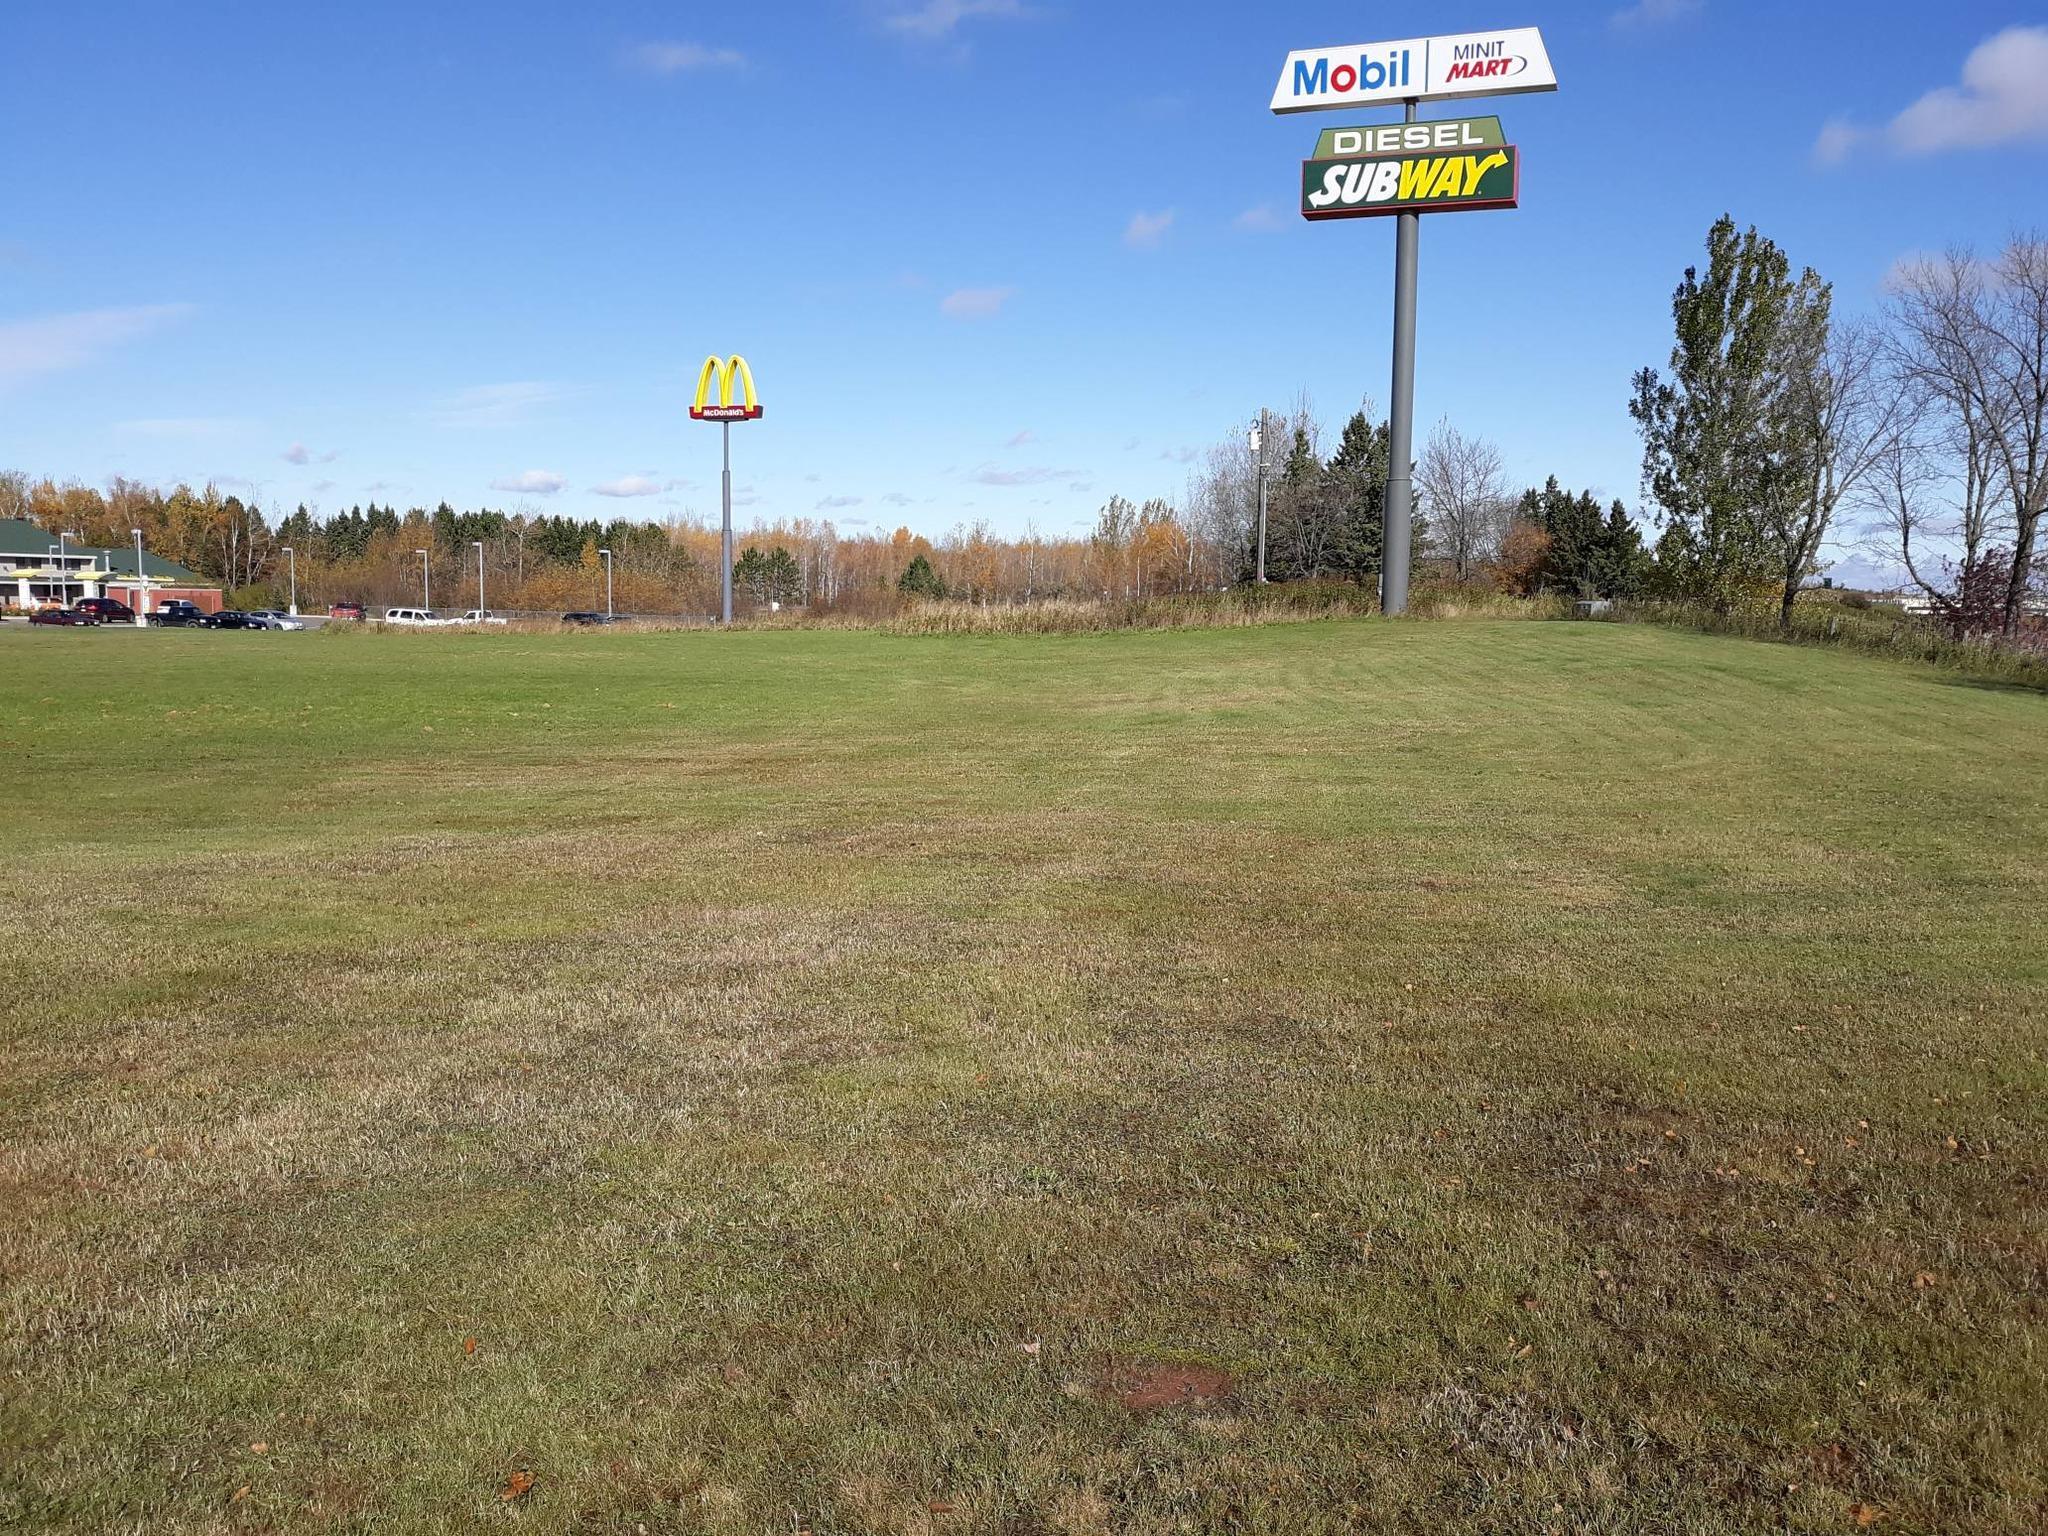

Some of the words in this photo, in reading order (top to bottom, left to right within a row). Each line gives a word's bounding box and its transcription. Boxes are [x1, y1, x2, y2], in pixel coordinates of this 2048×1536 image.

[1454, 40, 1505, 61] MINIT
[1293, 49, 1410, 96] Mobil
[1446, 54, 1513, 83] MART
[1333, 122, 1484, 154] DIESEL
[1308, 149, 1509, 208] SUBWAY
[703, 408, 744, 417] McDonald's
